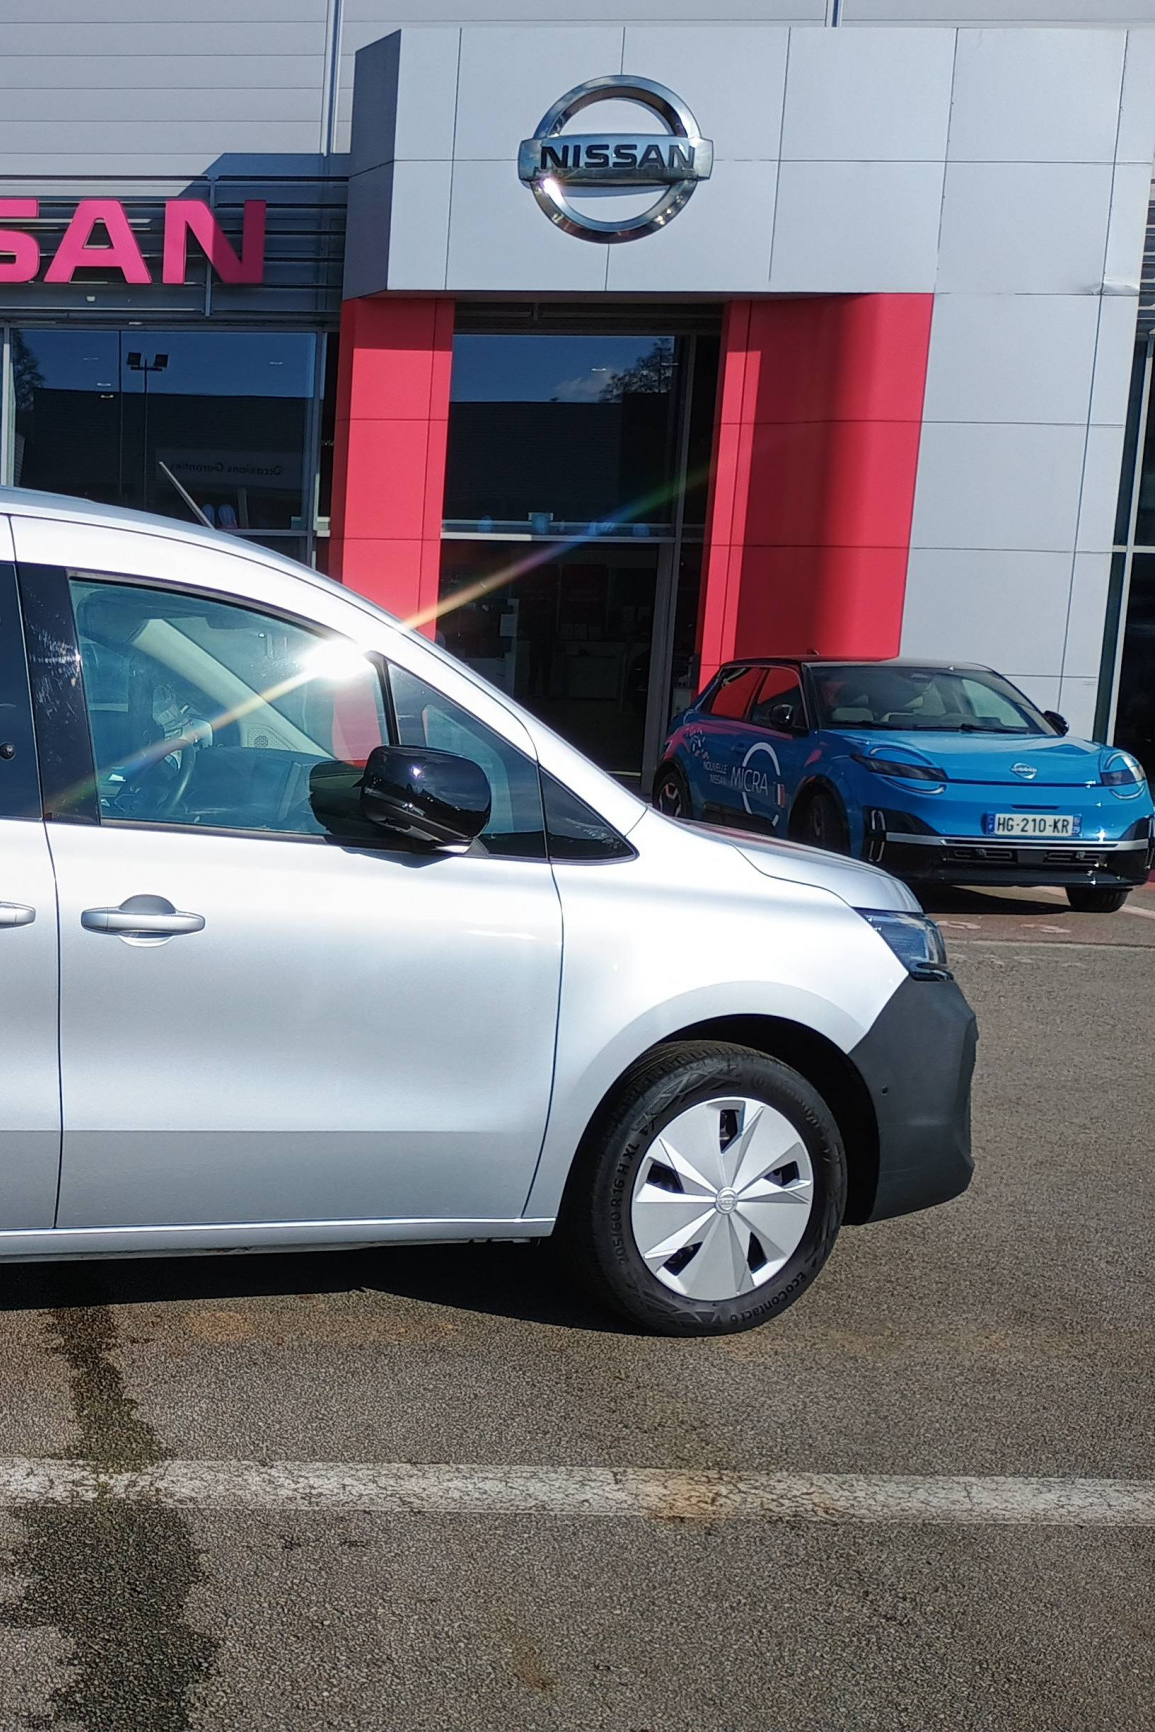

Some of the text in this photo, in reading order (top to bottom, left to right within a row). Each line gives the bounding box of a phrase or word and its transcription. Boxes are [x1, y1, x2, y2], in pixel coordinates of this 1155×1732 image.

[540, 144, 696, 170] NISSAN
[730, 766, 769, 796] MICRA
[996, 816, 1070, 834] HG-210-KR
[740, 1272, 806, 1322] EcoContact
